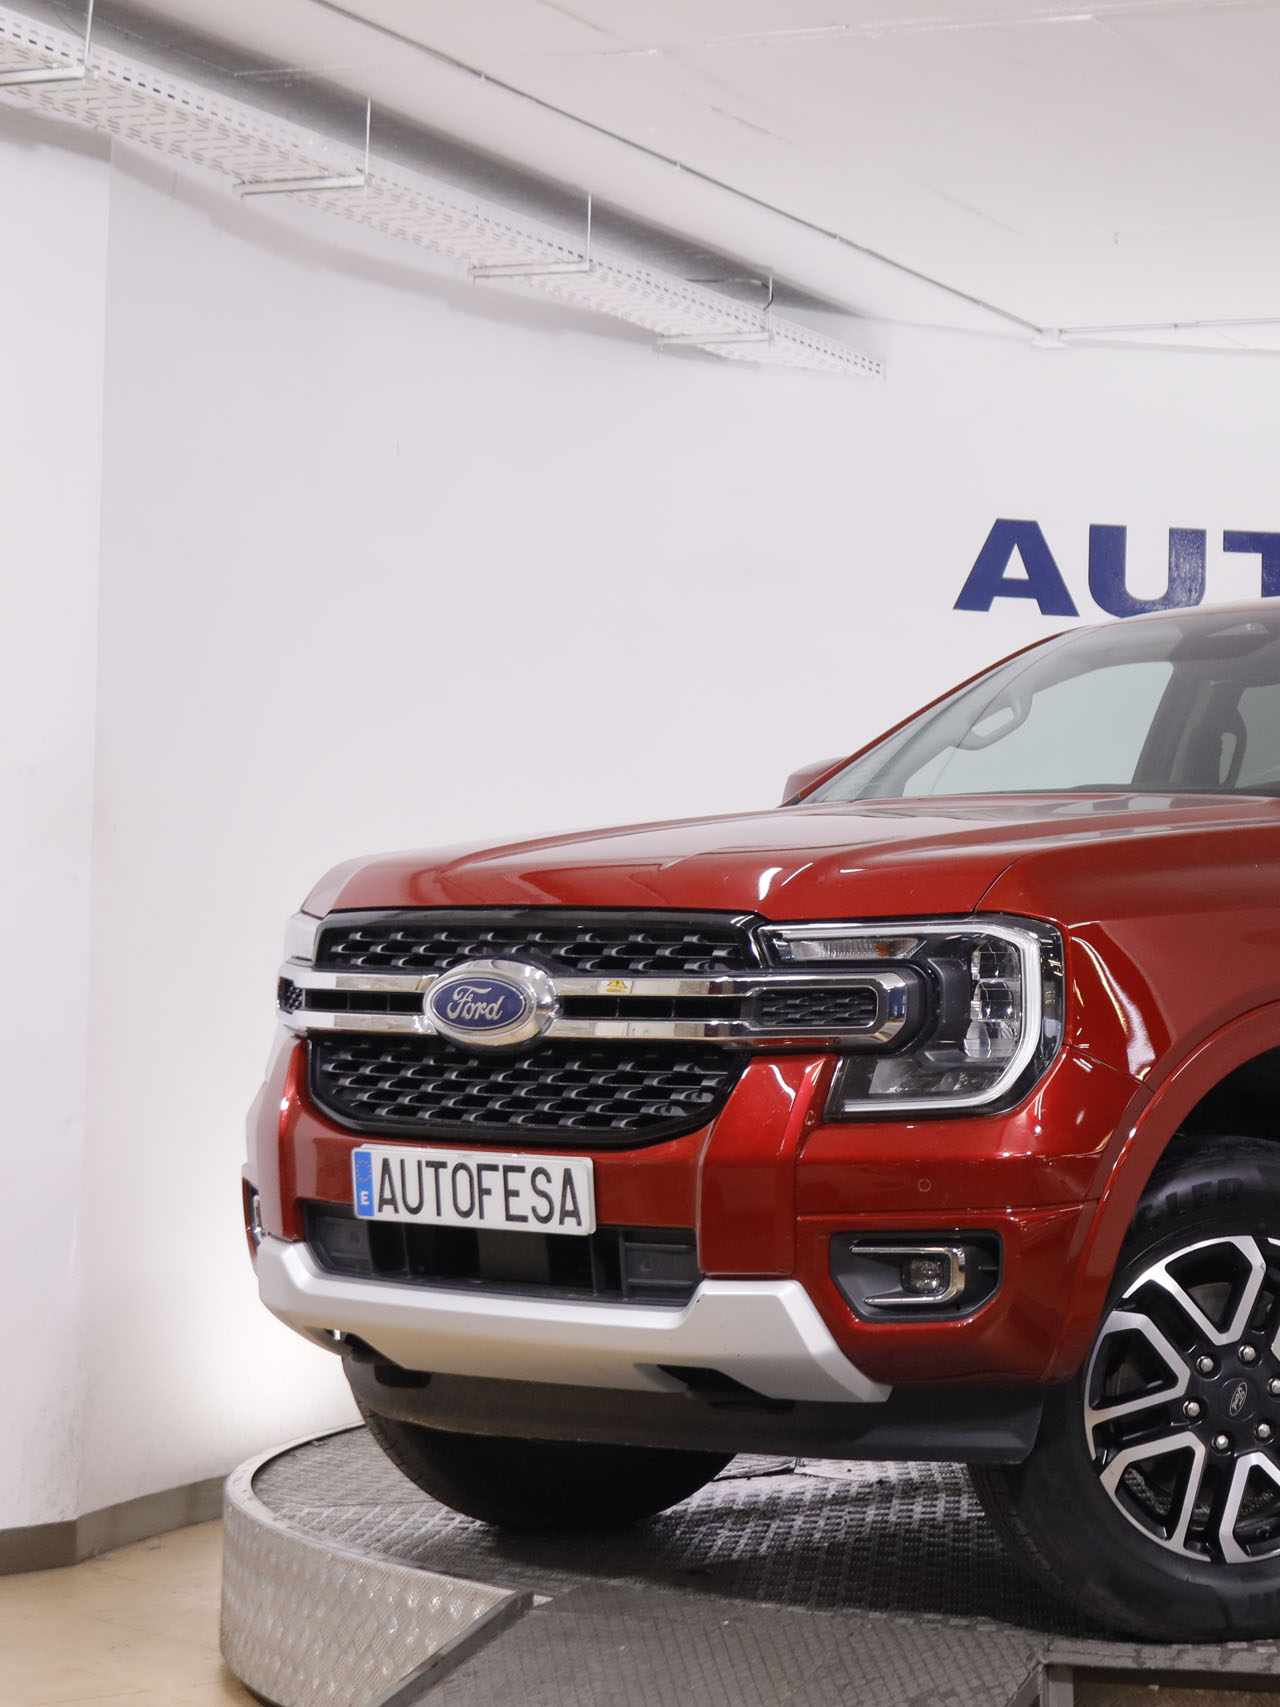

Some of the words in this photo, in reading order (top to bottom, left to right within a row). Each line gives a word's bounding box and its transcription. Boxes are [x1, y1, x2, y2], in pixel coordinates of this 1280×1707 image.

[447, 985, 505, 1020] Ford
[360, 1190, 370, 1206] E
[378, 1158, 582, 1227] AUTOFESA
